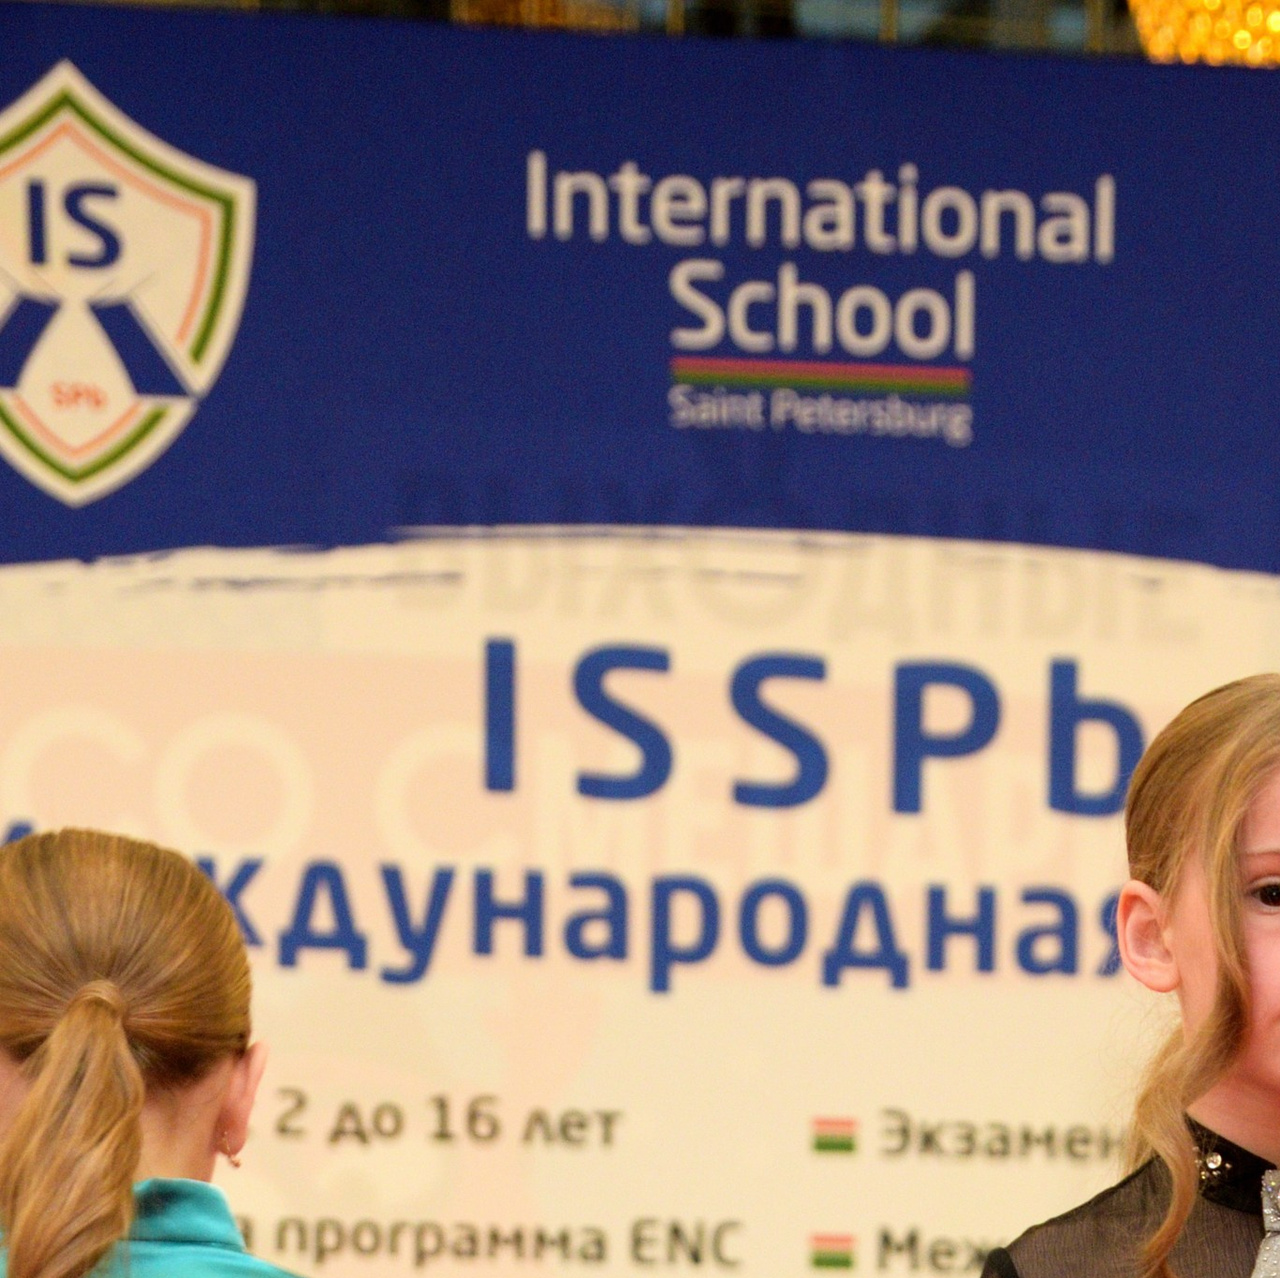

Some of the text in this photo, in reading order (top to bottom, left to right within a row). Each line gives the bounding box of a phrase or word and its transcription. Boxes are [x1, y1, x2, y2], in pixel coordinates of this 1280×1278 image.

[27, 179, 121, 268] IS
[526, 150, 1115, 264] International
[669, 258, 975, 360] School
[668, 385, 973, 447] Saint Petersburg
[484, 636, 1146, 816] ISSPb
[4, 820, 1118, 993] дународна
[273, 1088, 624, 1147] 2 до 16 лет
[275, 1214, 607, 1268] программа
[630, 1219, 744, 1267] ENC
[877, 1230, 1000, 1270] Меж
